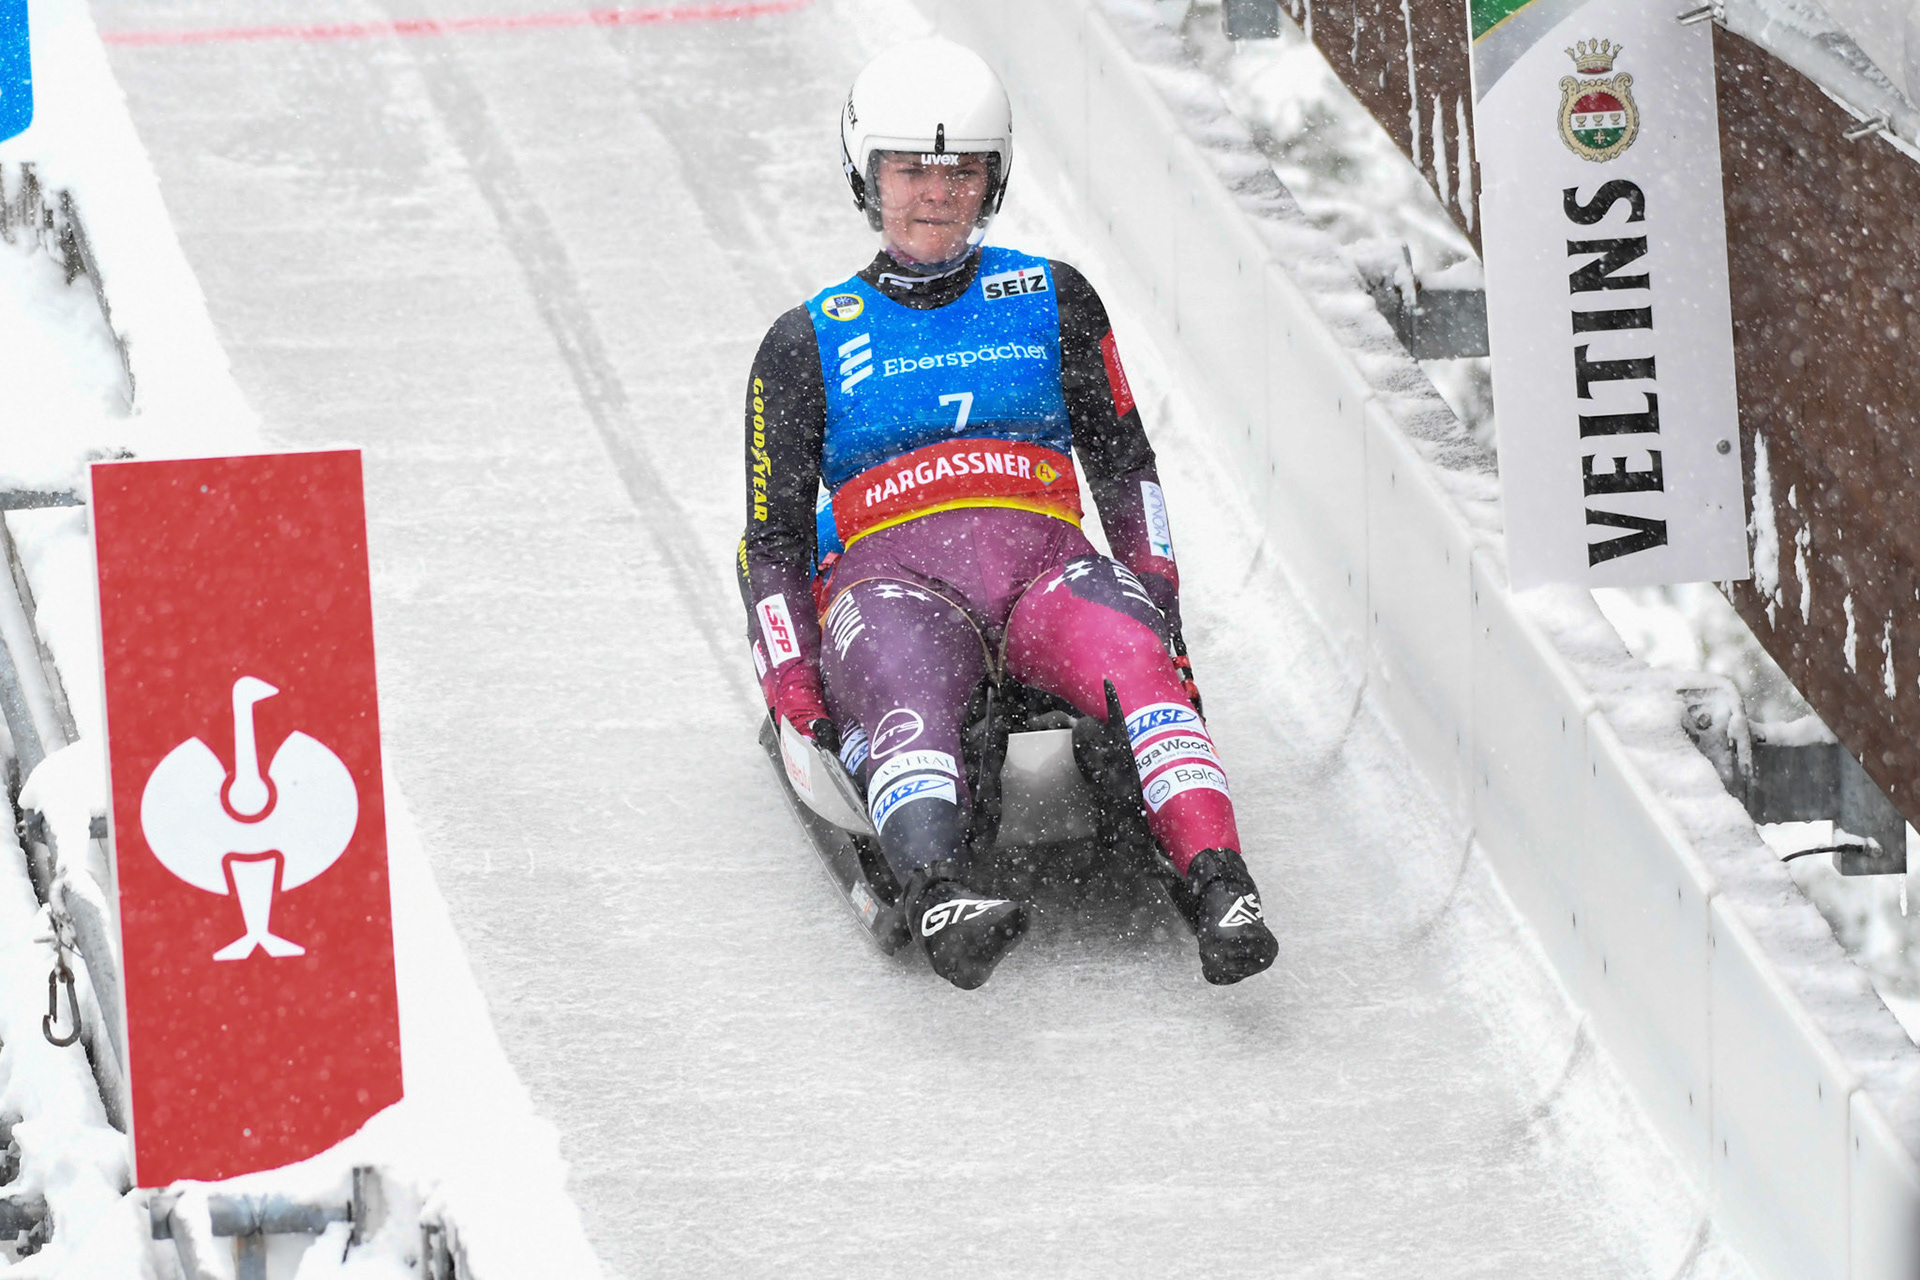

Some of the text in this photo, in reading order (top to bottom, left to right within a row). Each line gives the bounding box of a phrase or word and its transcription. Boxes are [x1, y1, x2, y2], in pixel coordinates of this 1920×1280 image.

[920, 153, 959, 166] uvex
[883, 342, 1049, 378] Eberspächer
[1562, 179, 1669, 569] VELTINS
[938, 391, 974, 433] 7
[865, 452, 1031, 508] HARGASSNER
[1135, 748, 1162, 771] iga
[1159, 738, 1211, 753] Wood
[921, 898, 1011, 938] GTS
